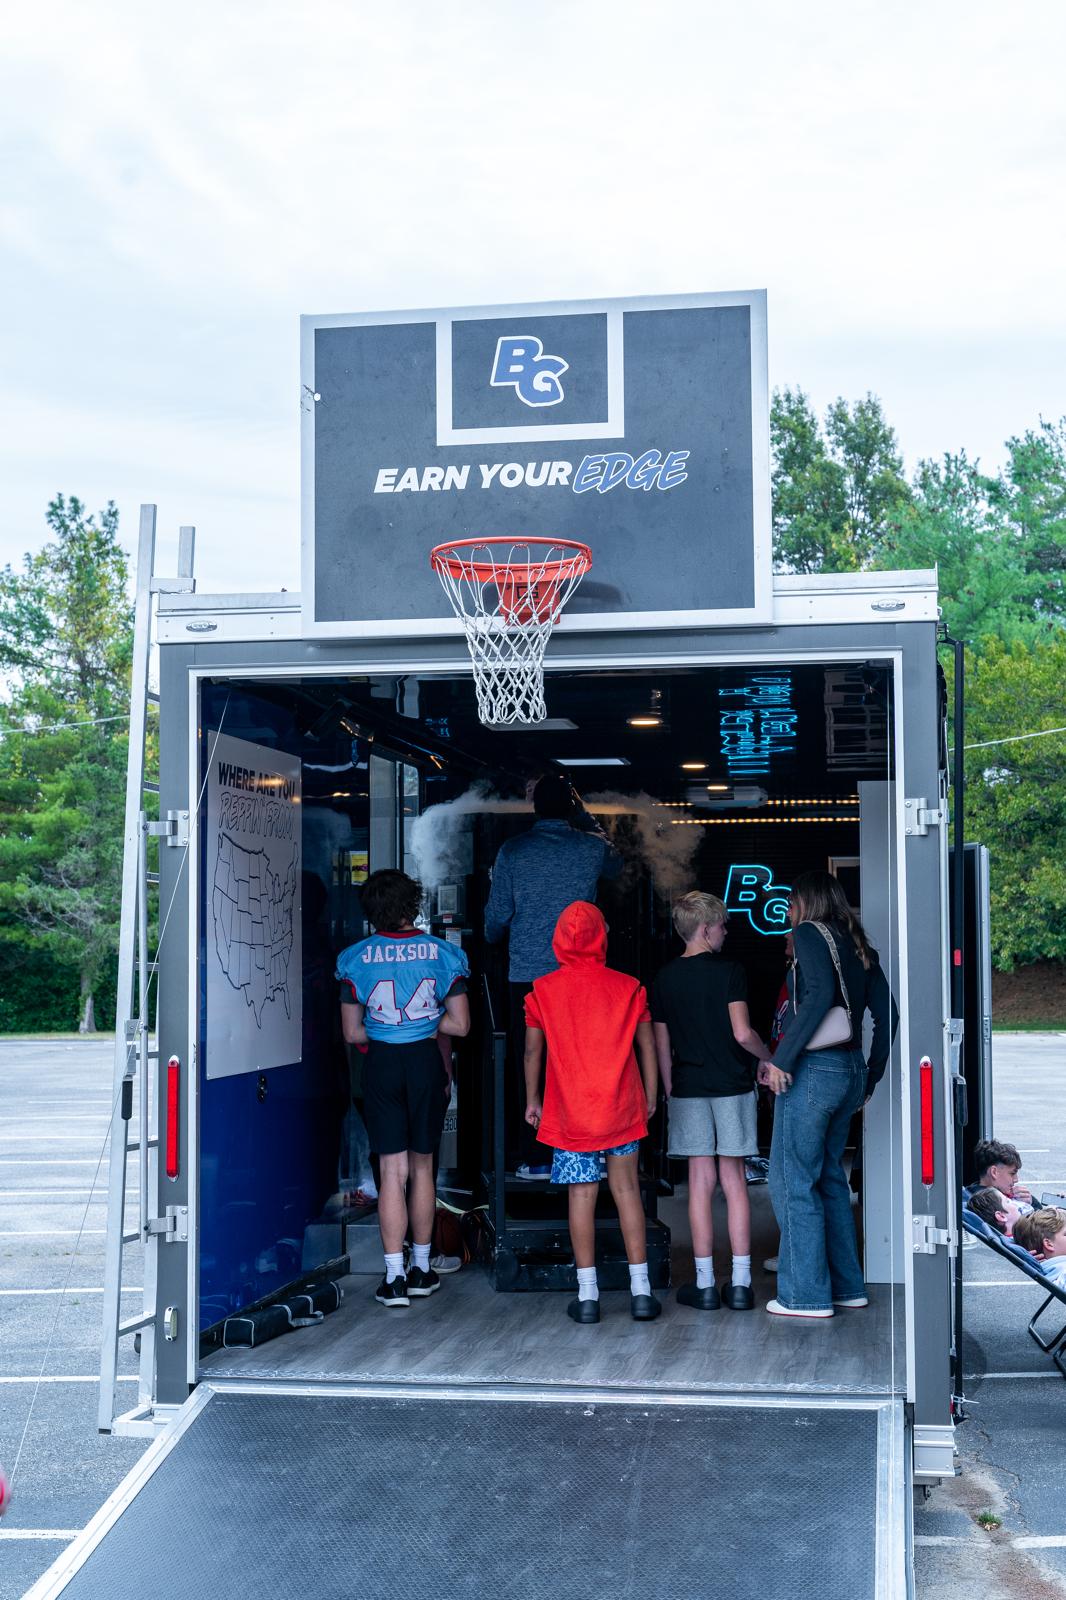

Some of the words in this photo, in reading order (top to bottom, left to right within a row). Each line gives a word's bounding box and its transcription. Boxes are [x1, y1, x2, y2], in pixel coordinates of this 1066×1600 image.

[490, 335, 569, 407] BG
[373, 465, 470, 493] EARN
[478, 461, 573, 489] YOUR
[572, 449, 690, 494] EDGE
[218, 762, 255, 792] WHERE
[256, 772, 275, 797] ARE
[278, 777, 296, 800] YOU
[263, 801, 294, 840] FROM
[723, 864, 793, 936] BG
[361, 942, 439, 964] JACKSON
[366, 977, 440, 1026] 44
